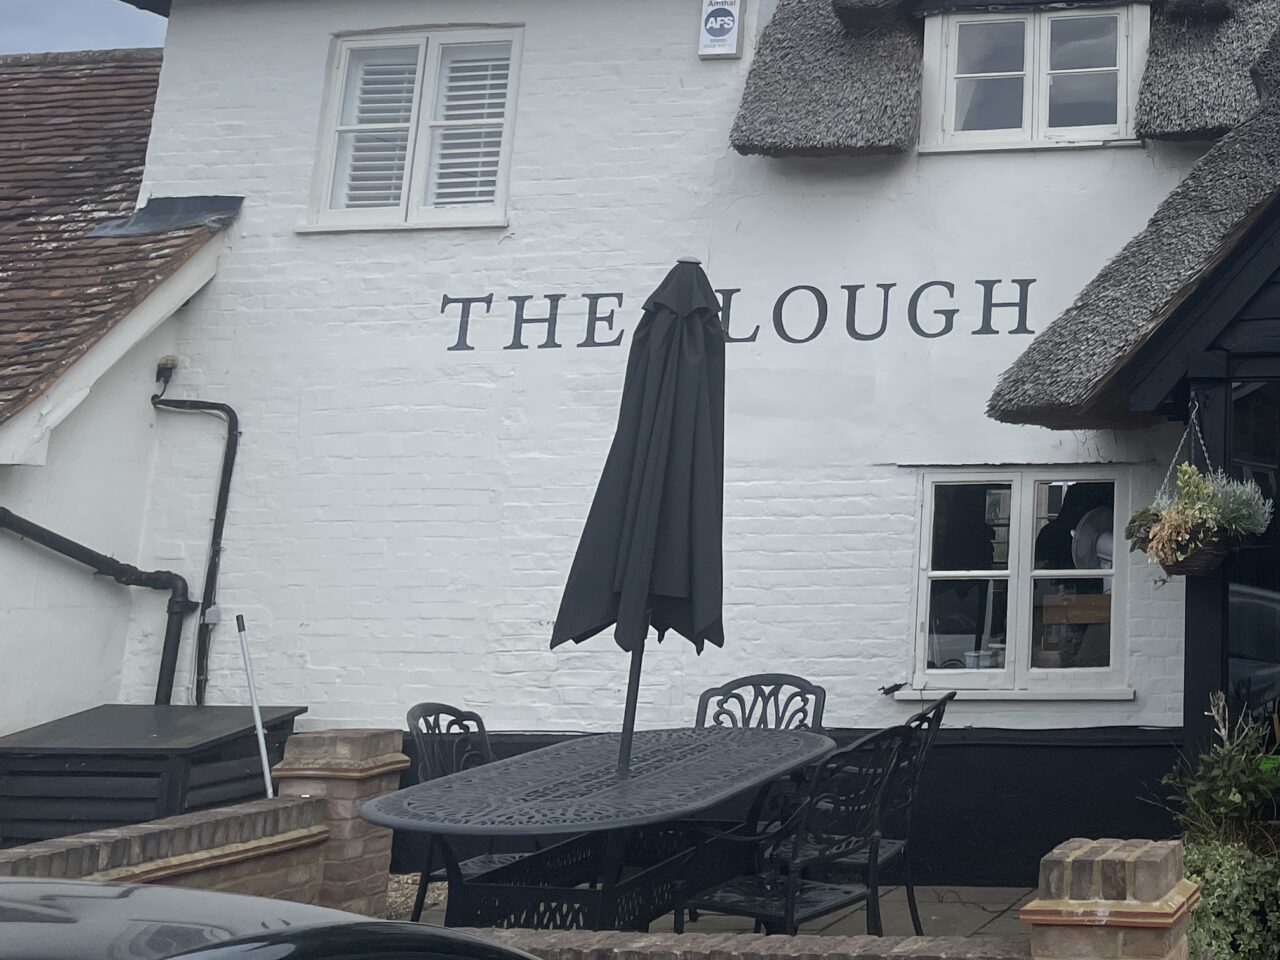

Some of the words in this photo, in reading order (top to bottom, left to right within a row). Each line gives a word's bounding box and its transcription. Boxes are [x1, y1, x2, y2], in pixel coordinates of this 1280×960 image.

[706, 17, 734, 29] AFS
[440, 292, 625, 351] THE
[714, 278, 1037, 344] LOUGH
